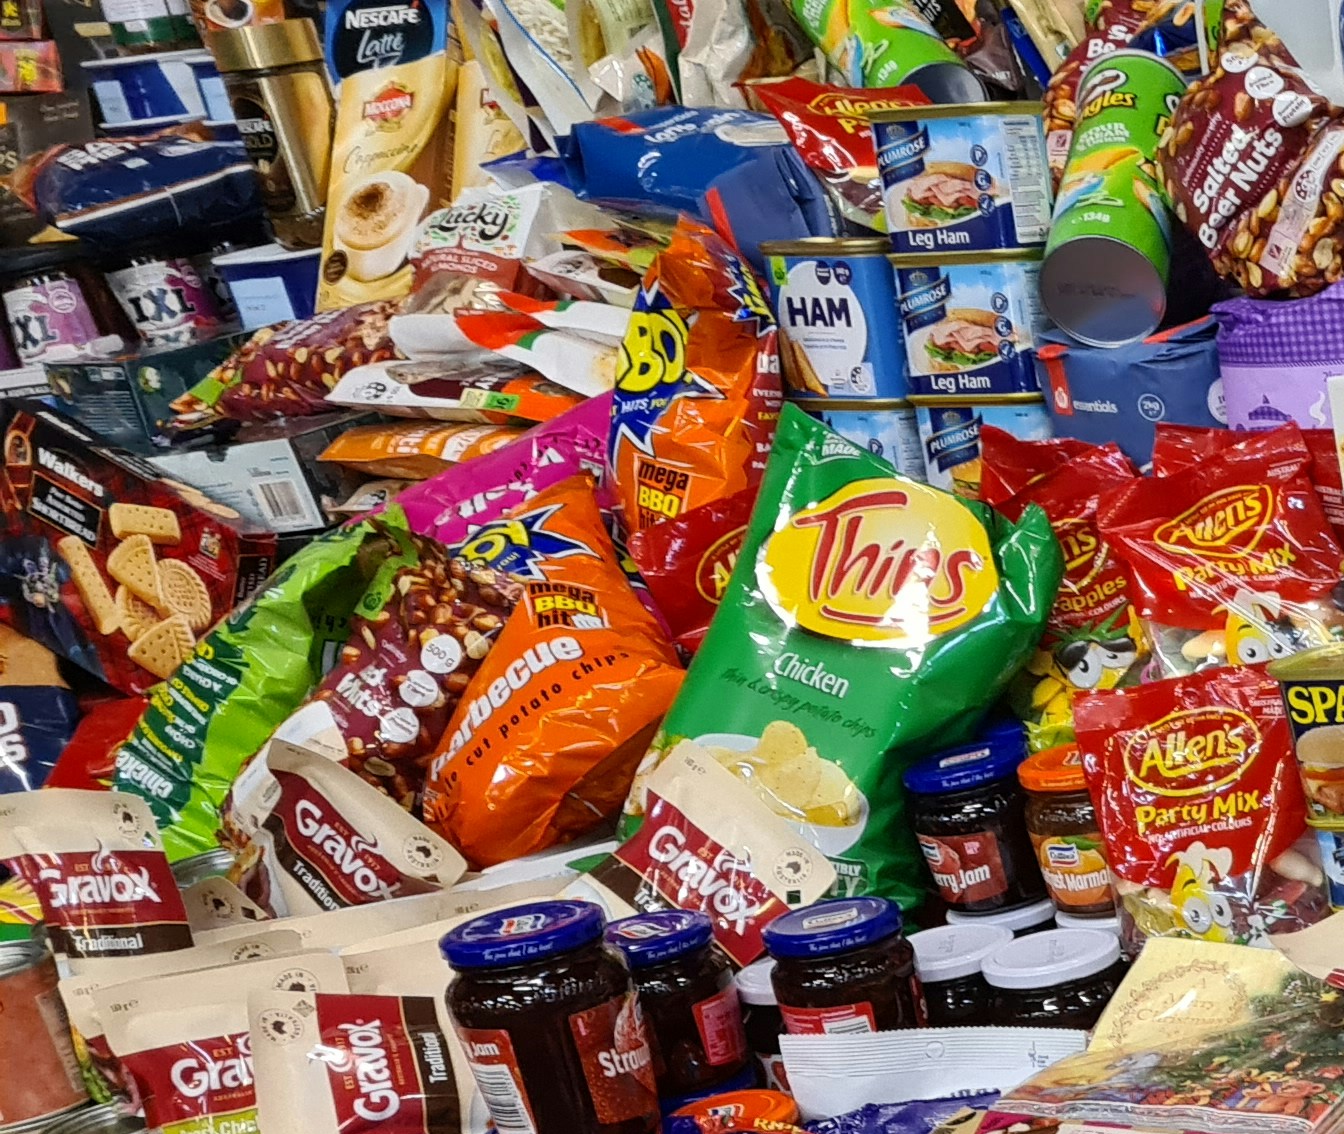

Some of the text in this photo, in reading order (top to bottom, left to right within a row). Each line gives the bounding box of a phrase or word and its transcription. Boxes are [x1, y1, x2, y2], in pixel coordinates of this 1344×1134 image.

[429, 202, 510, 238] Lucky
[908, 228, 970, 249] Leg Ham
[134, 289, 196, 324] IXL
[787, 295, 852, 329] HAM
[930, 372, 991, 394] Leg Ham
[36, 446, 104, 498] Walkers
[792, 491, 980, 611] Thins
[774, 652, 850, 700] Chicken
[1135, 789, 1260, 835] Party Mix
[429, 1031, 453, 1083] Traditional
